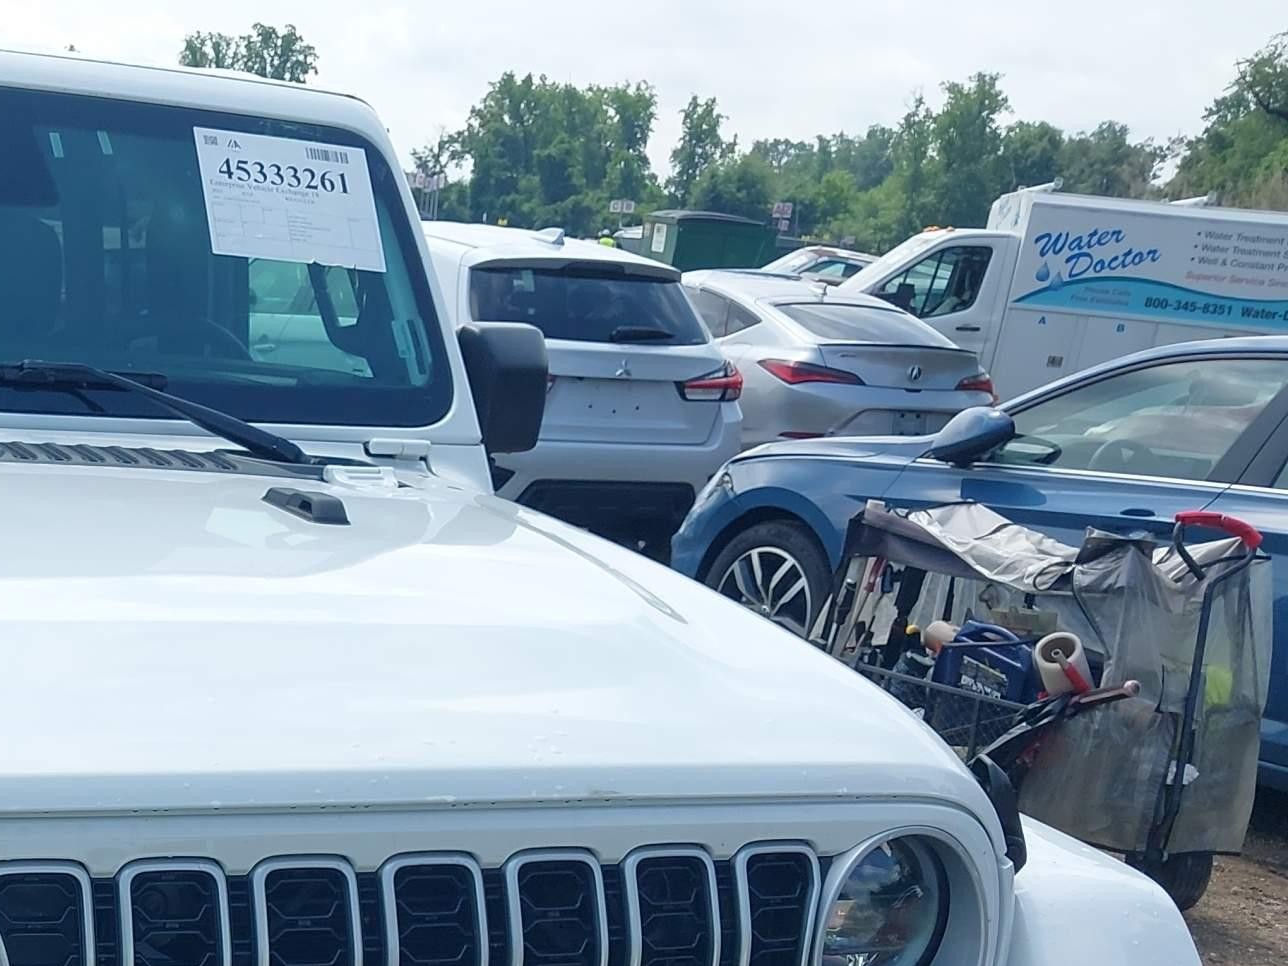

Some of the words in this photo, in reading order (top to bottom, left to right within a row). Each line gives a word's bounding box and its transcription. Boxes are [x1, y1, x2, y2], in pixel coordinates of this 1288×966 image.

[218, 157, 349, 194] 45333261
[1034, 228, 1126, 258] Water
[1204, 230, 1233, 241] Water
[1236, 232, 1285, 246] Treatment
[1201, 243, 1230, 254] Water
[1232, 246, 1282, 258] Treatment
[1065, 247, 1162, 279] Doctor
[1144, 296, 1233, 317] 800-345-8351
[1038, 315, 1047, 325] A
[1116, 323, 1126, 333] B
